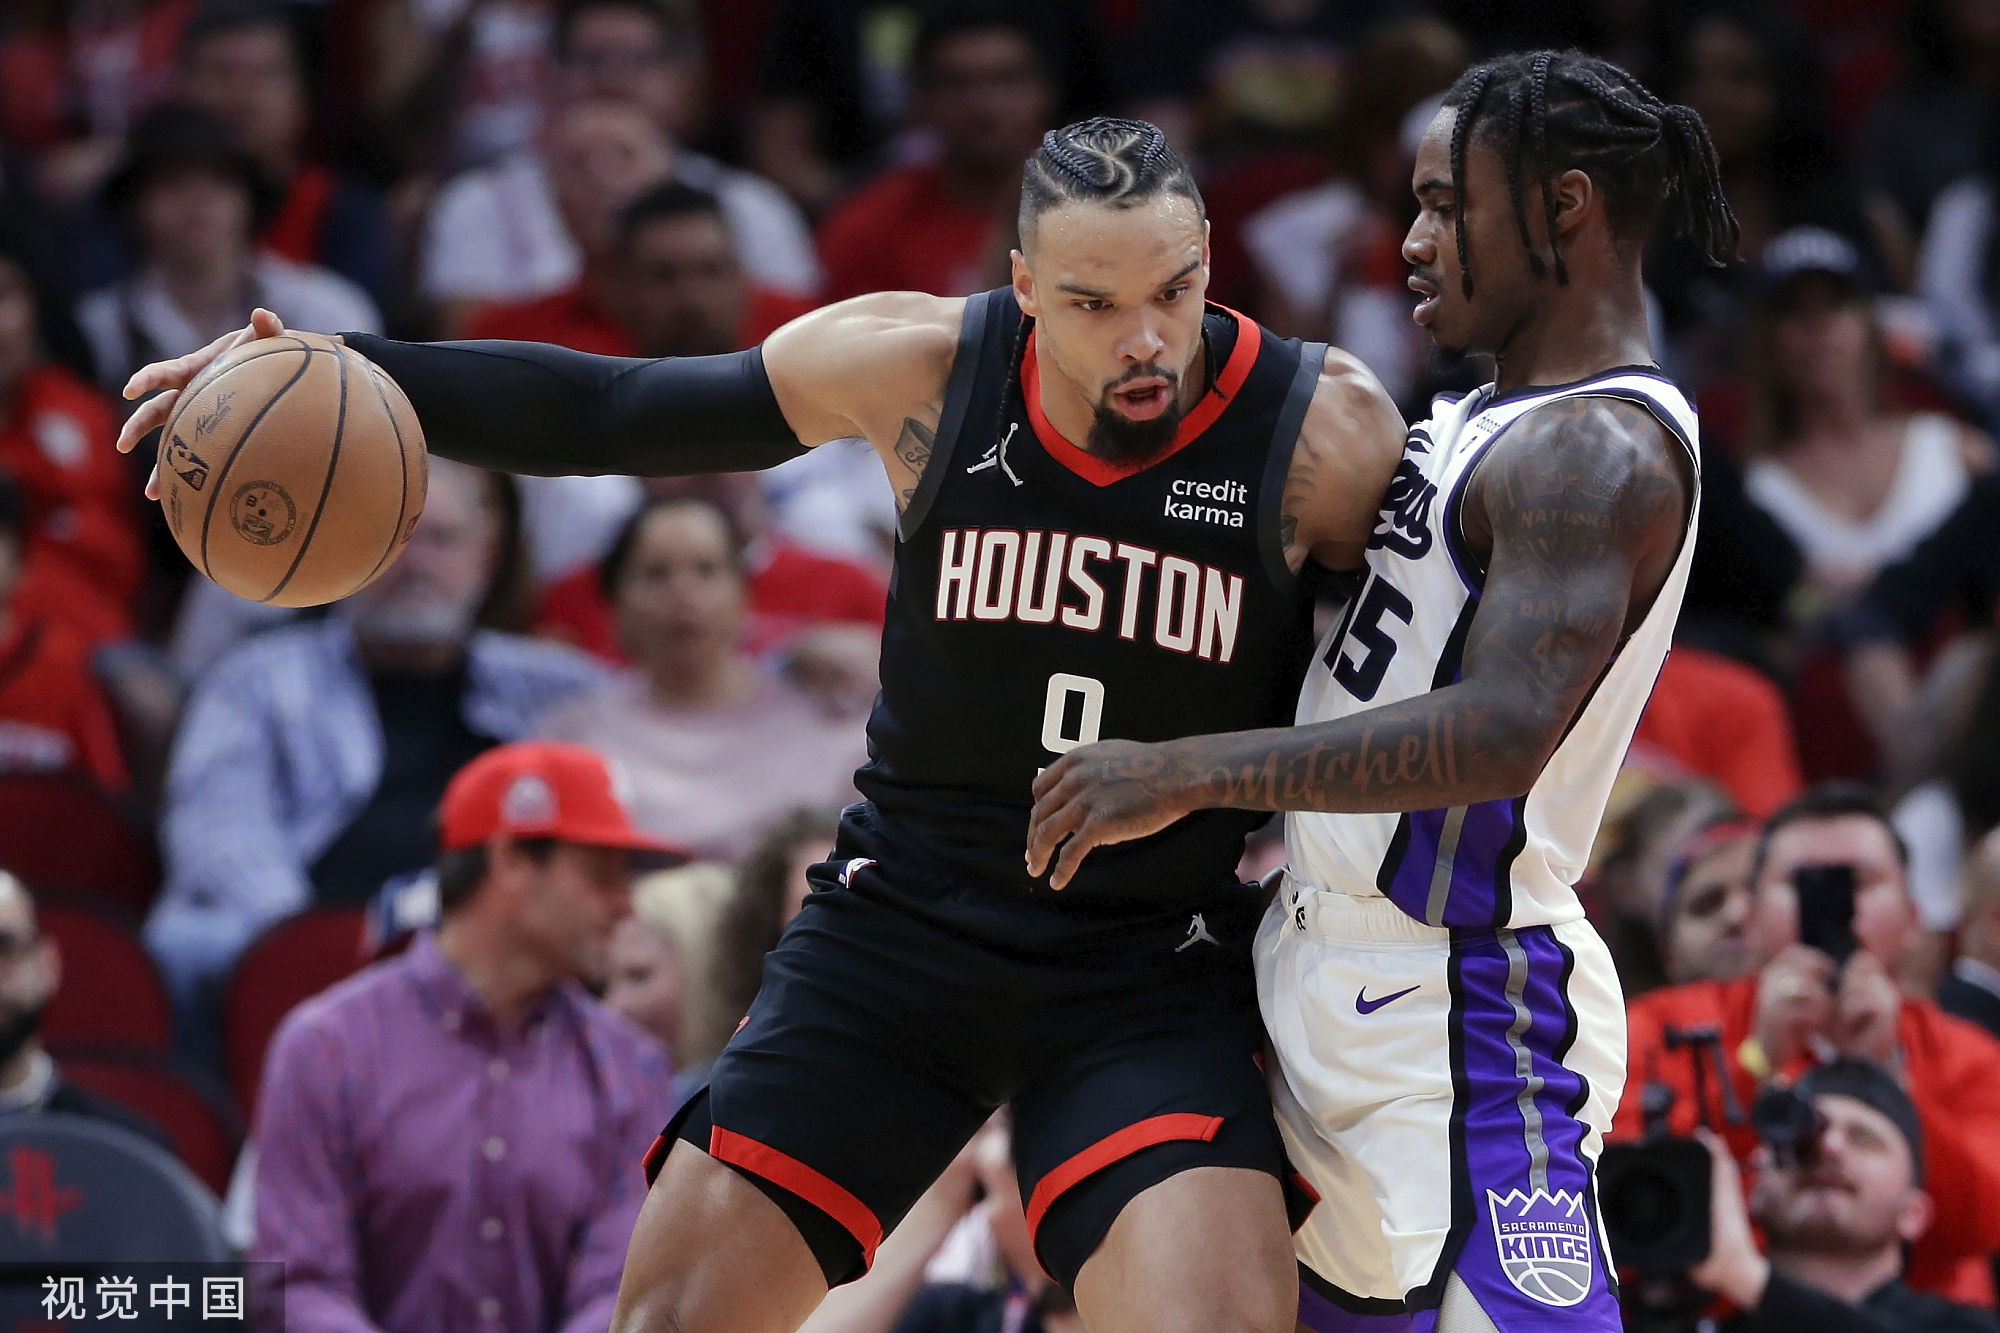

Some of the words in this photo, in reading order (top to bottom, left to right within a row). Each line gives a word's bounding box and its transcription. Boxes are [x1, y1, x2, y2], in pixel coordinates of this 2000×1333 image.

[1171, 479, 1248, 504] credit
[1163, 494, 1245, 528] karma
[935, 528, 1245, 664] HOUSTON
[1207, 711, 1459, 809] Mitchell
[1501, 1221, 1585, 1235] SACRAMENTO
[1500, 1236, 1589, 1263] KINGS
